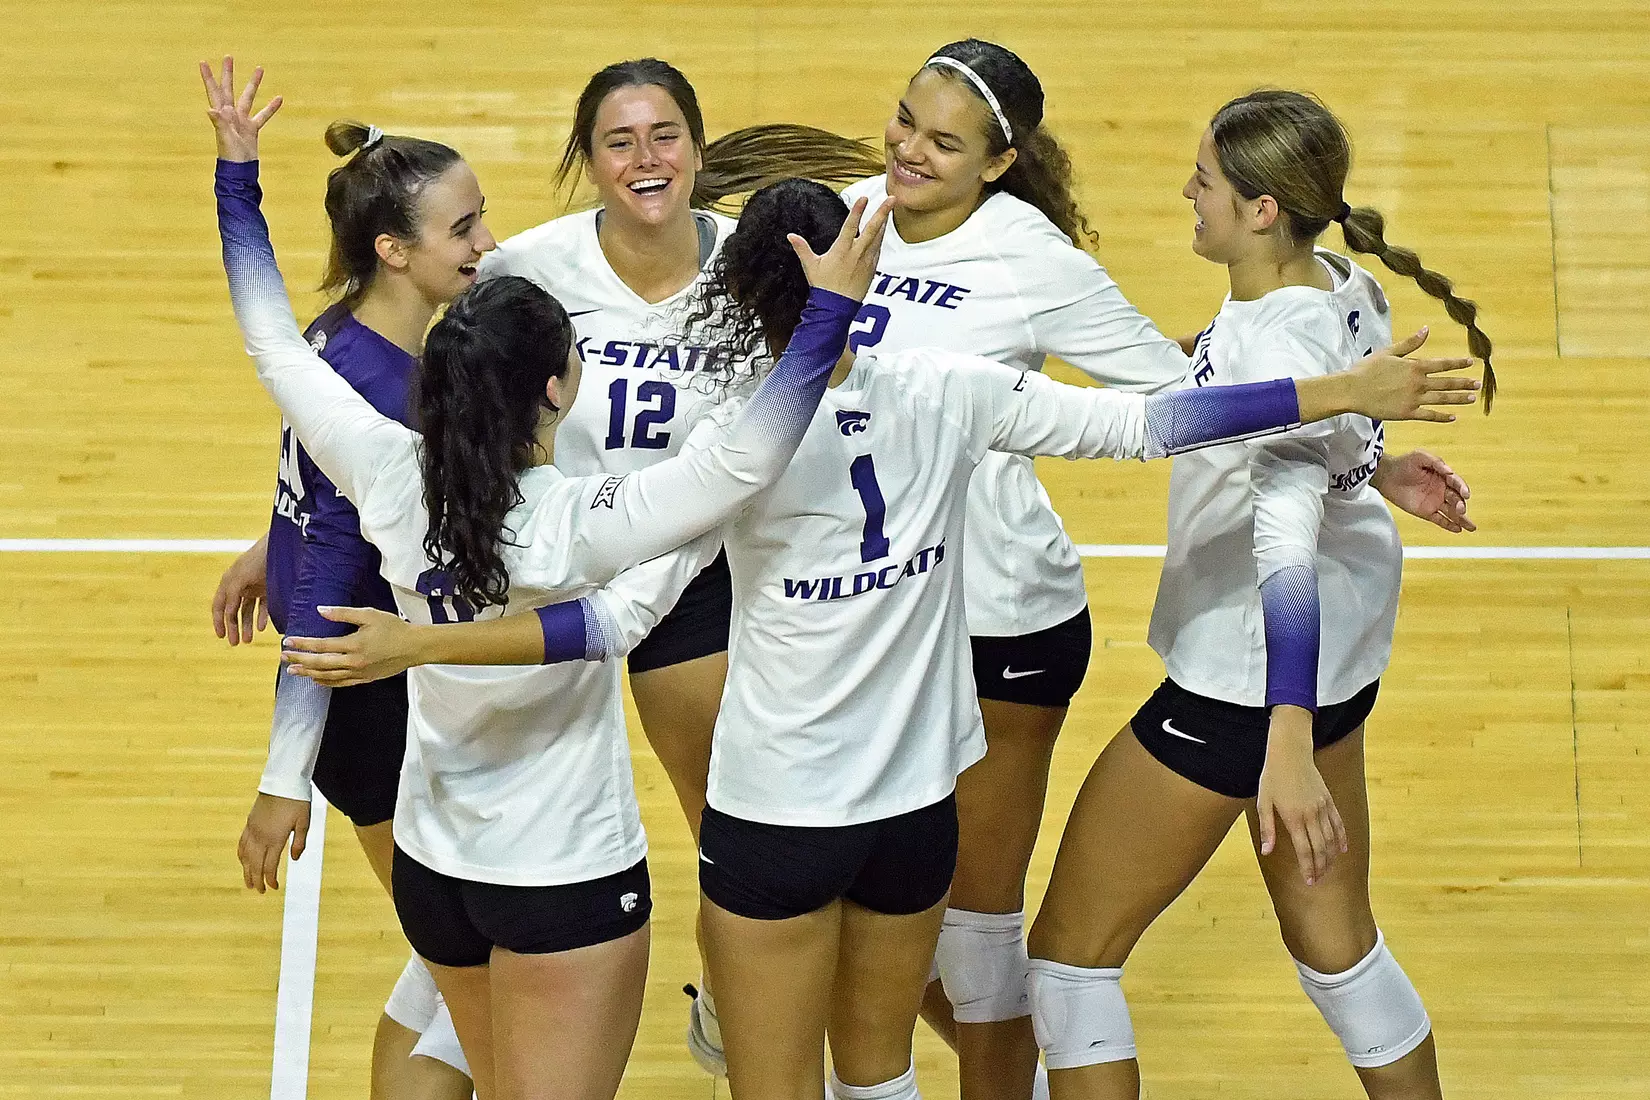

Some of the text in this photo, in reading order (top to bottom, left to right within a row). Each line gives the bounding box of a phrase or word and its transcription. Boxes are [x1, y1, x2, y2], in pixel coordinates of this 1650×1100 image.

[874, 271, 972, 310] TATE
[848, 303, 892, 355] 2
[605, 378, 677, 450] 12
[849, 453, 890, 564] 1
[783, 537, 946, 601] WILDCATS
